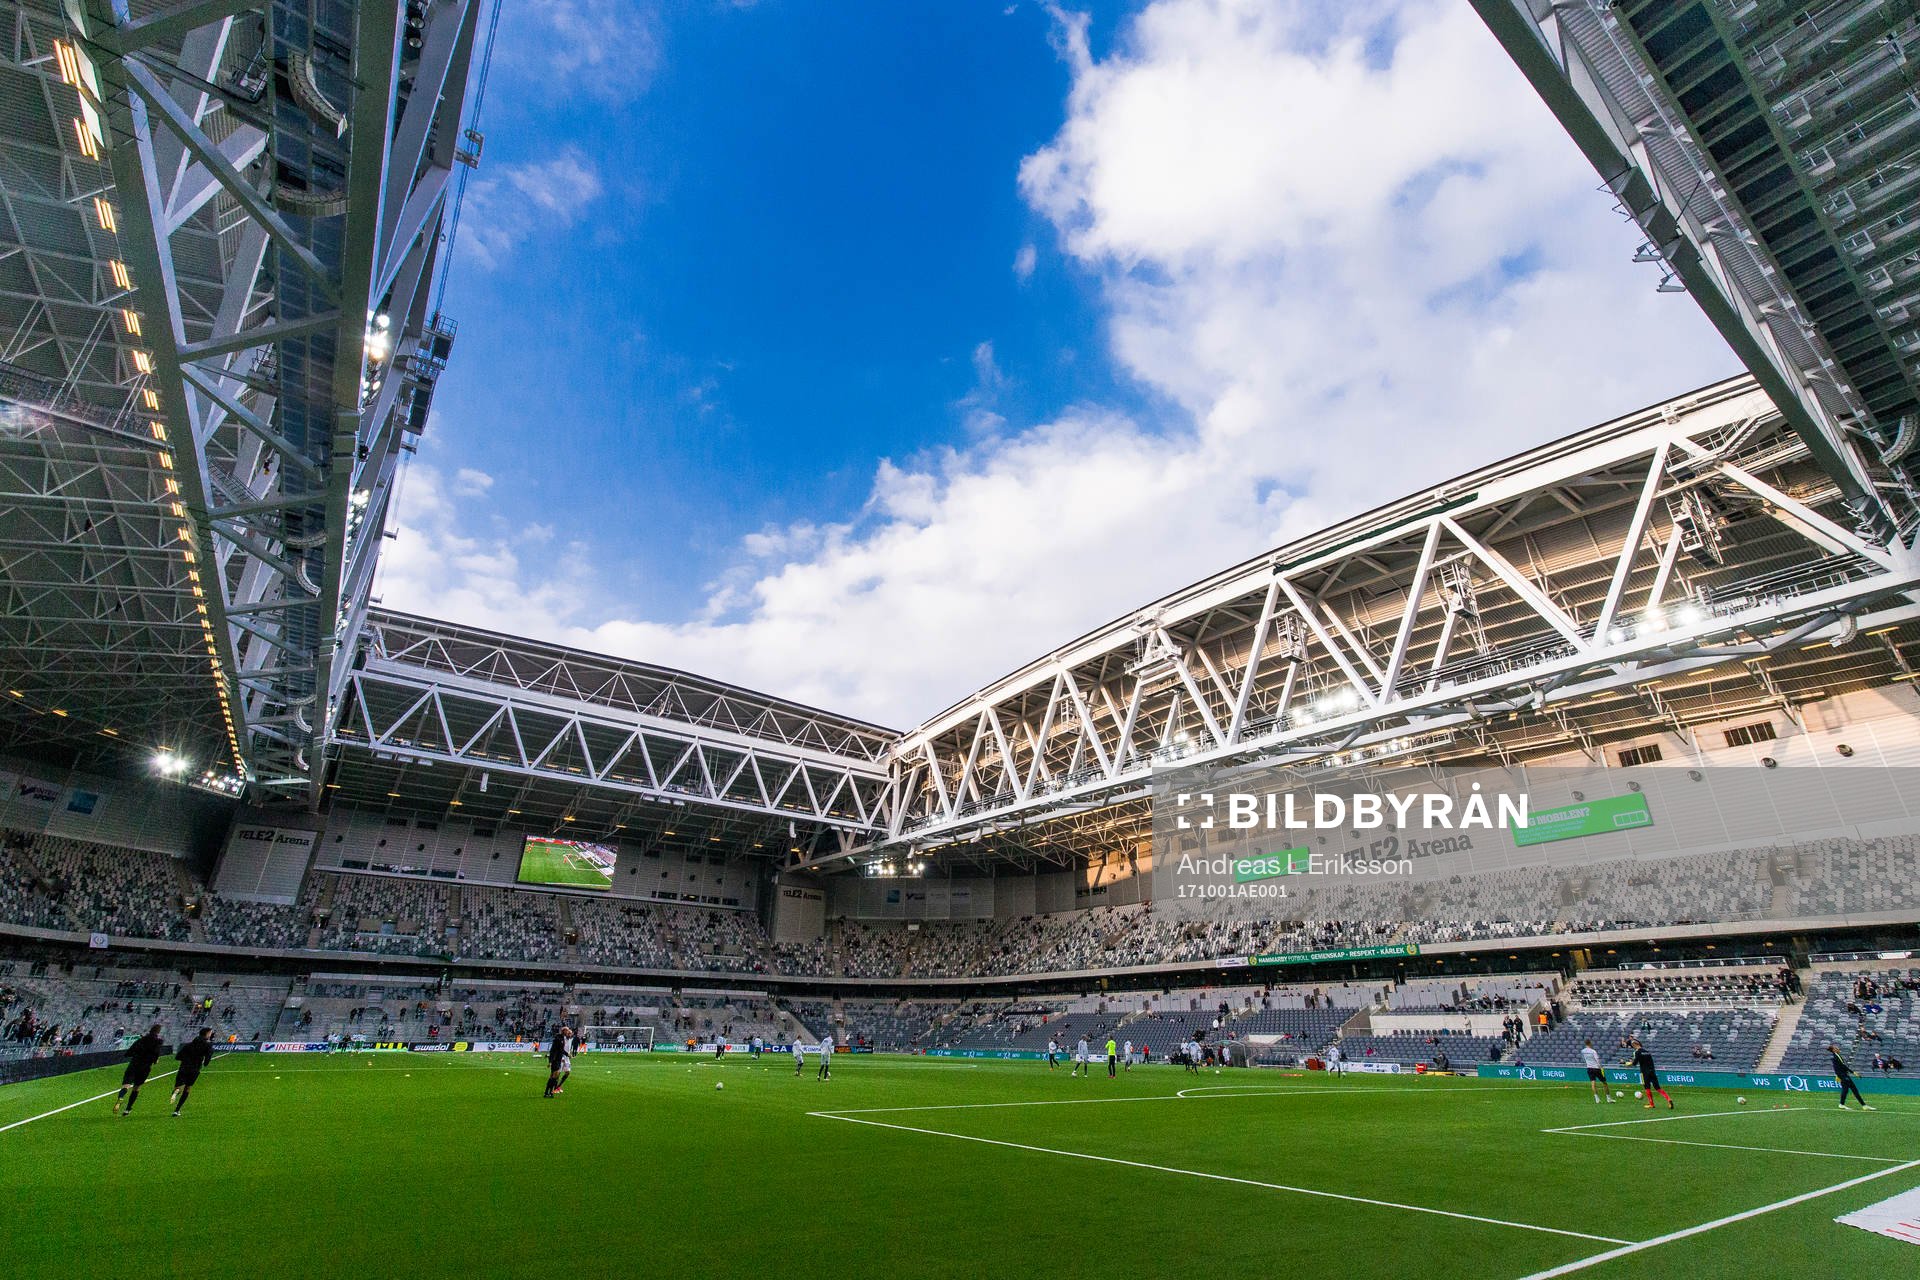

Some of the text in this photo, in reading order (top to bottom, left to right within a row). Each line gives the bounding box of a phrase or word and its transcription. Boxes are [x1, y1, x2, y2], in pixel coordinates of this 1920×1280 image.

[1536, 807, 1590, 825] MOBILEN?
[275, 834, 310, 846] Arena
[1343, 834, 1473, 869] TELE2 Arena
[275, 1043, 329, 1051] INTERSPOR
[1542, 1070, 1565, 1078] ENERGI
[1613, 1072, 1628, 1080] VVS
[1667, 1075, 1694, 1083] ENERGI
[1752, 1078, 1770, 1086] VVS
[1818, 1081, 1842, 1089] ENER
